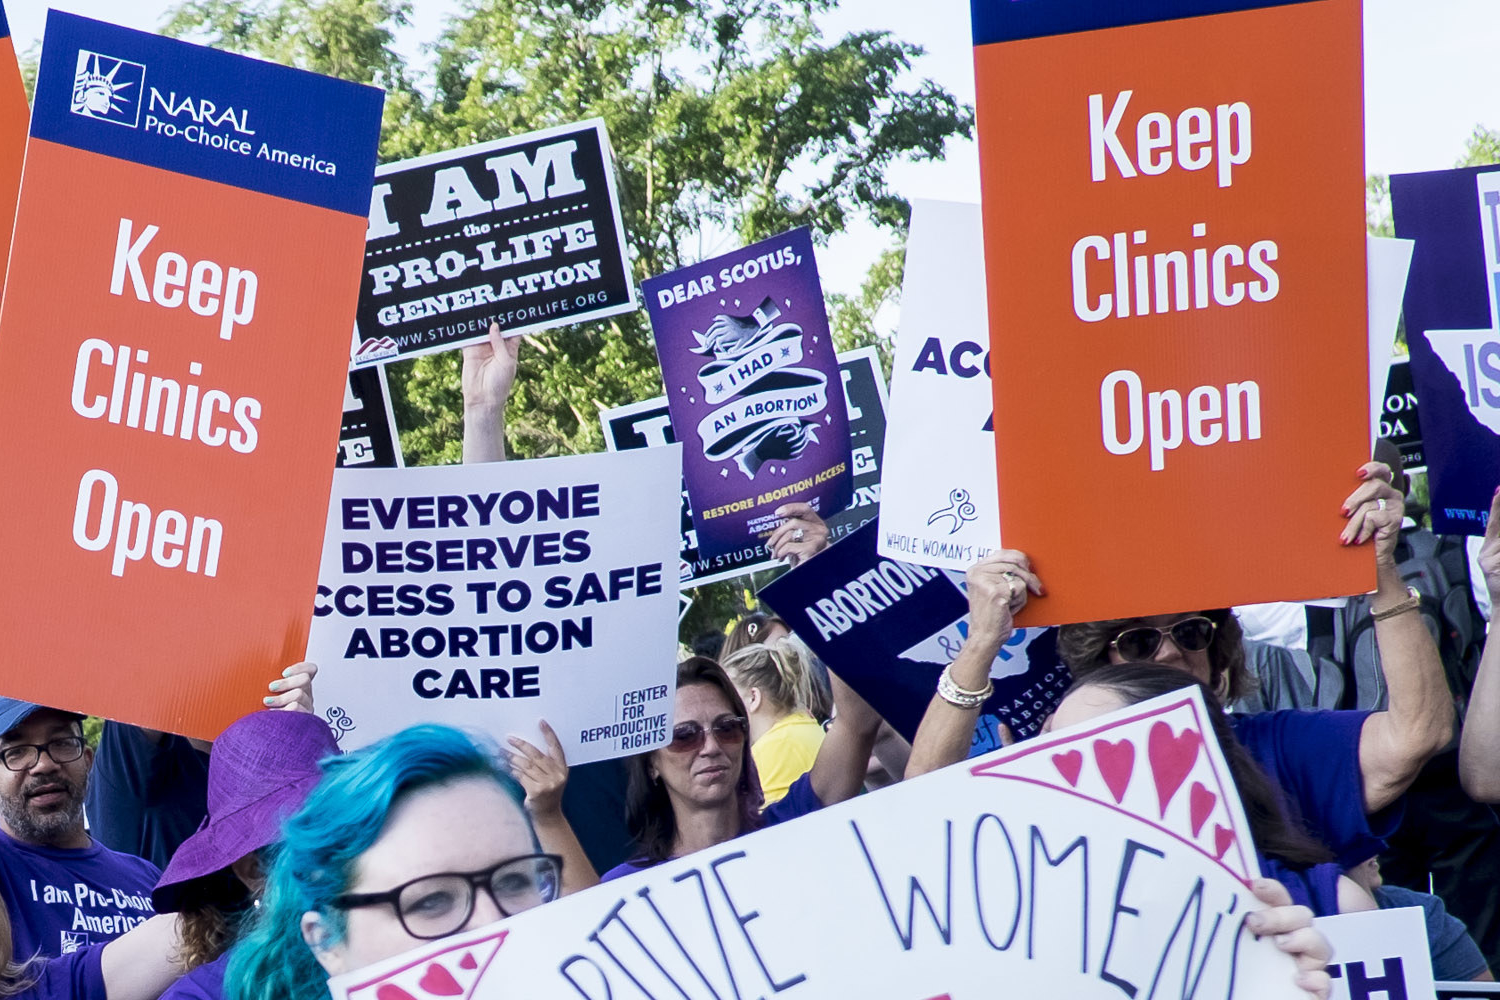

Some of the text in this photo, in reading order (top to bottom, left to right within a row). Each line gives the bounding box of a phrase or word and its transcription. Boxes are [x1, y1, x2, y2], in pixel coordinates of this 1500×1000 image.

[149, 87, 255, 135] NARAL
[145, 114, 336, 176] Pro-Choice America
[1088, 90, 1252, 188] Keep
[421, 139, 586, 228] AM
[462, 222, 491, 238] the
[109, 217, 259, 341] Keep
[368, 219, 597, 296] PRO-LIFE
[657, 245, 803, 310] DEAR SCOTUS,
[1071, 223, 1280, 323] Clinics
[377, 259, 601, 327] GENERATION
[394, 290, 608, 348] WW.STUDENTSFORLIFE.ORG
[728, 352, 774, 386] I HAD
[911, 337, 992, 378] AC
[70, 337, 262, 454] Clinics
[713, 412, 737, 433] AN
[744, 393, 819, 419] ABORTION
[1100, 370, 1261, 471] Open
[341, 484, 600, 530] EVERYONE
[702, 498, 755, 521] RESTORE
[756, 476, 814, 506] ABORTION
[814, 462, 846, 485] ACCESS
[72, 468, 223, 577] Open
[886, 532, 918, 554] WHOLE
[922, 539, 973, 561] WOMAN'S
[341, 530, 591, 574] DESERVES
[466, 580, 532, 614] TO
[544, 563, 663, 607] SAFE
[343, 616, 593, 659] ABORTION
[412, 666, 541, 699] CARE
[622, 684, 668, 707] CENTER
[580, 713, 667, 744] REPRODUCTIVE
[622, 705, 645, 721] FOR
[621, 728, 666, 751] RIGHTS
[30, 879, 39, 902] I
[43, 885, 74, 905] am
